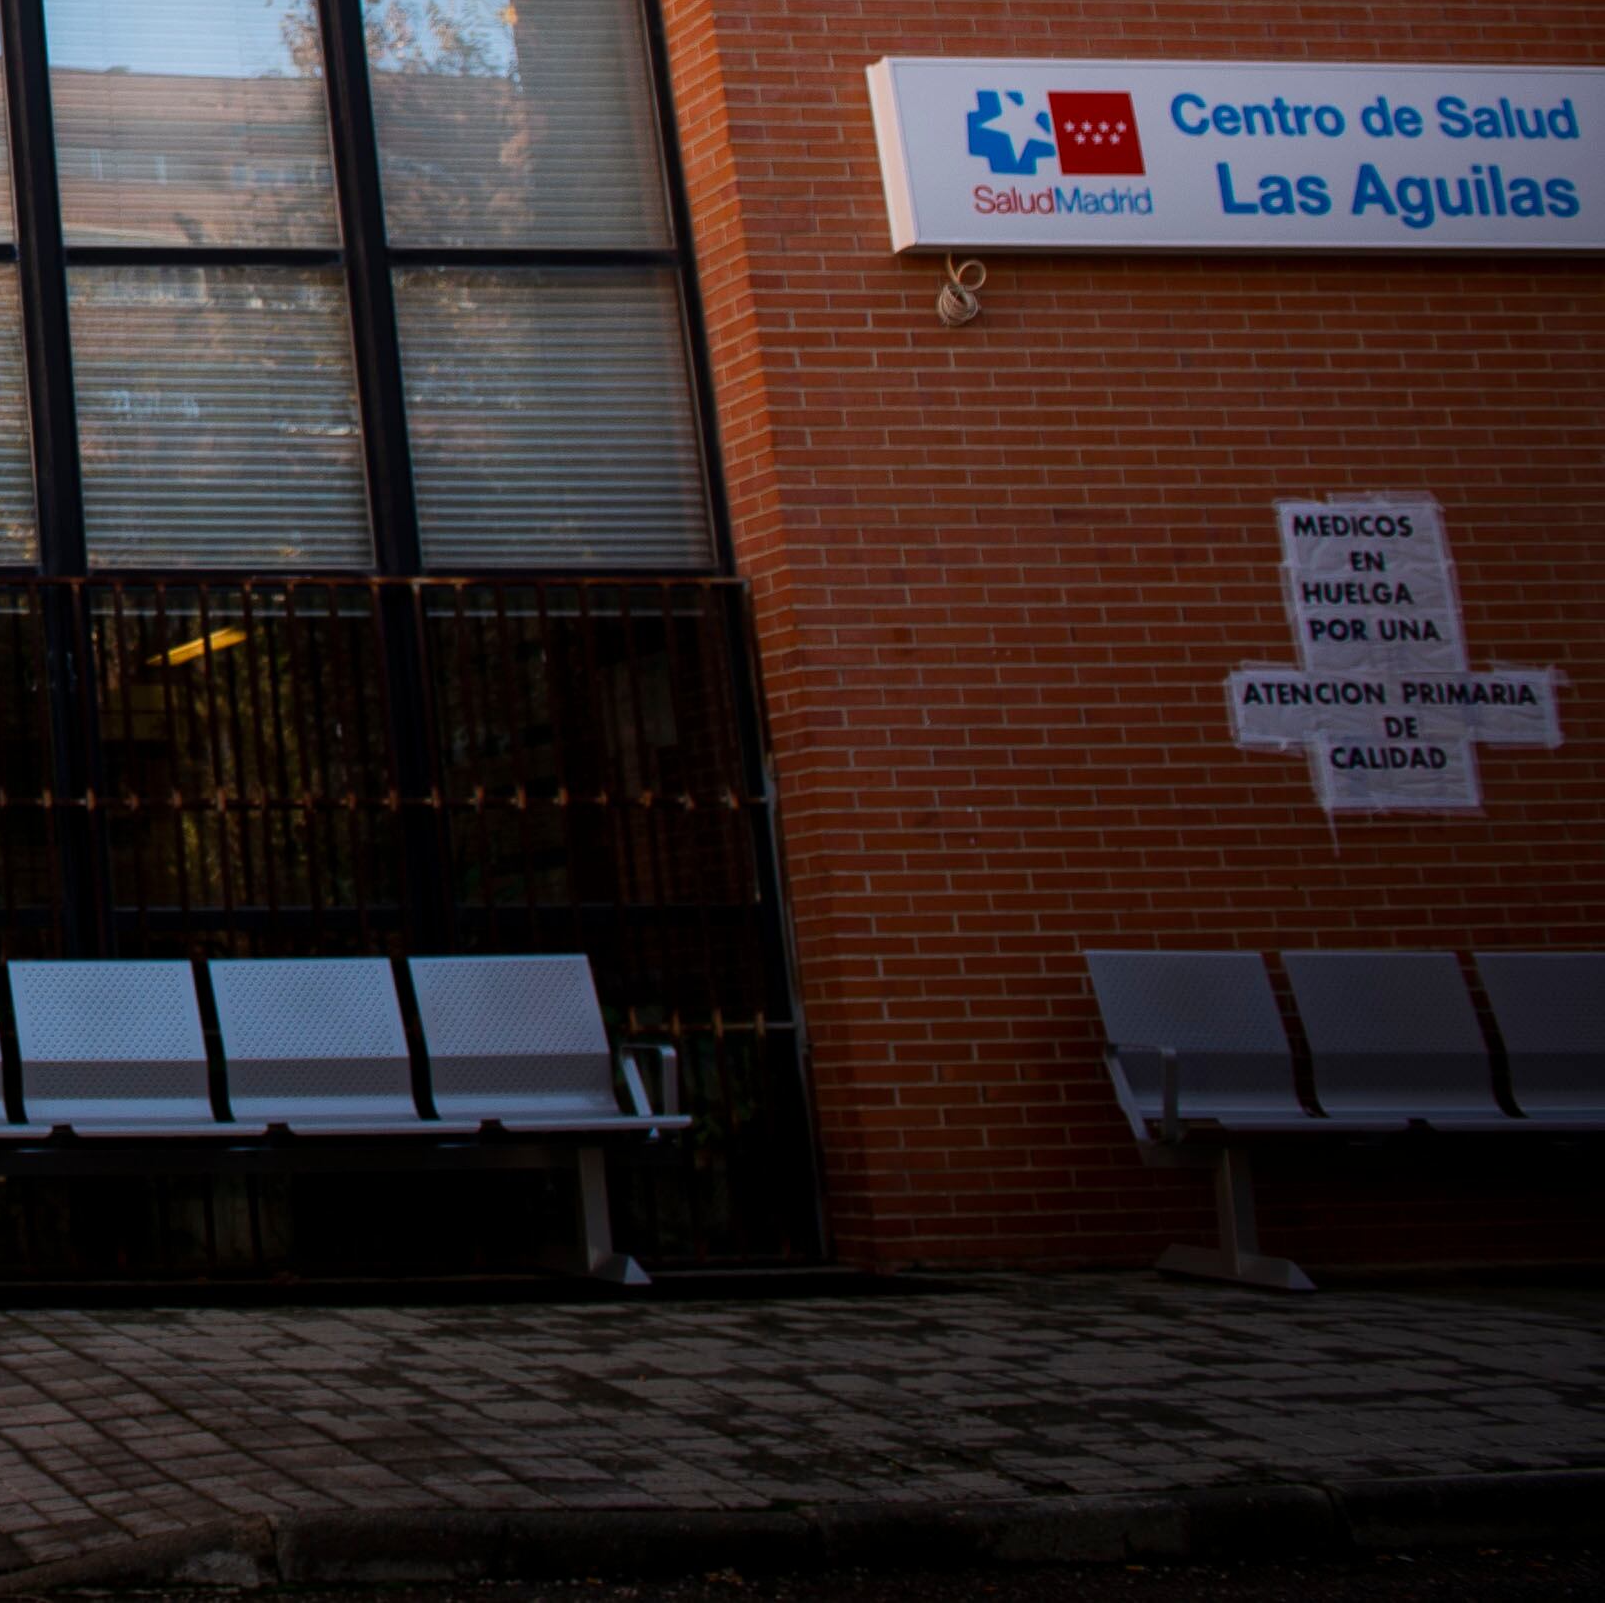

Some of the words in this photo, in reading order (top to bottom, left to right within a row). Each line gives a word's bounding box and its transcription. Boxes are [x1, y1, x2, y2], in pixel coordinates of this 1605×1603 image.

[1170, 92, 1348, 138] Centro
[1360, 95, 1424, 138] de
[1438, 94, 1582, 140] Salud
[974, 184, 1154, 215] SaludMadrid
[1216, 161, 1332, 216] Las
[1351, 162, 1582, 230] Aguilas
[1292, 515, 1415, 538] MEDICOS
[1350, 551, 1386, 573] EN
[1302, 582, 1415, 605] HUELGA
[1309, 619, 1369, 642] POR
[1379, 619, 1442, 642] UNA
[1242, 682, 1387, 706] ATENCION
[1400, 682, 1539, 707] PRIMARIA
[1384, 717, 1419, 740] DE
[1330, 747, 1448, 771] CALIDAD
